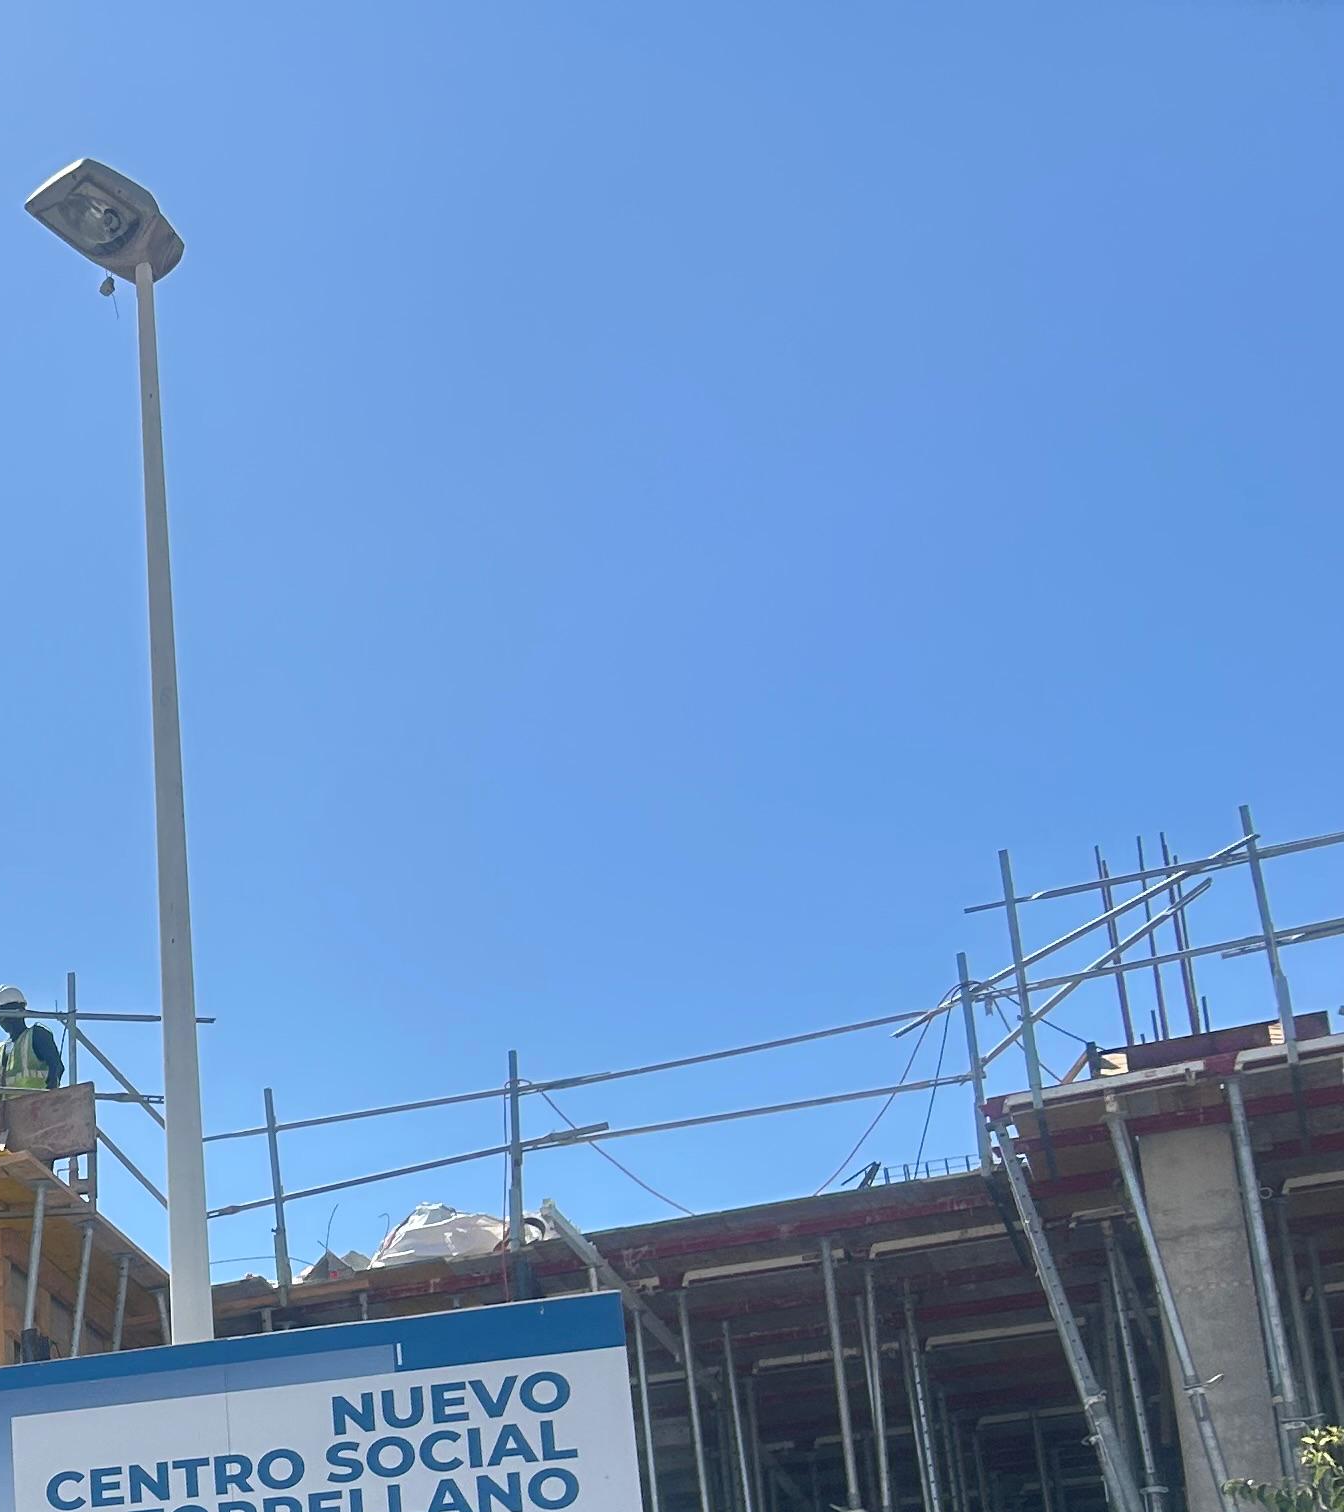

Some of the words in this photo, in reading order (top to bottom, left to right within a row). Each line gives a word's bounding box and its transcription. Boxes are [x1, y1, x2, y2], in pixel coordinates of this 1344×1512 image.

[331, 1370, 572, 1437] NUEVO
[45, 1448, 306, 1512] CENTRO
[325, 1419, 579, 1484] SOCIAL
